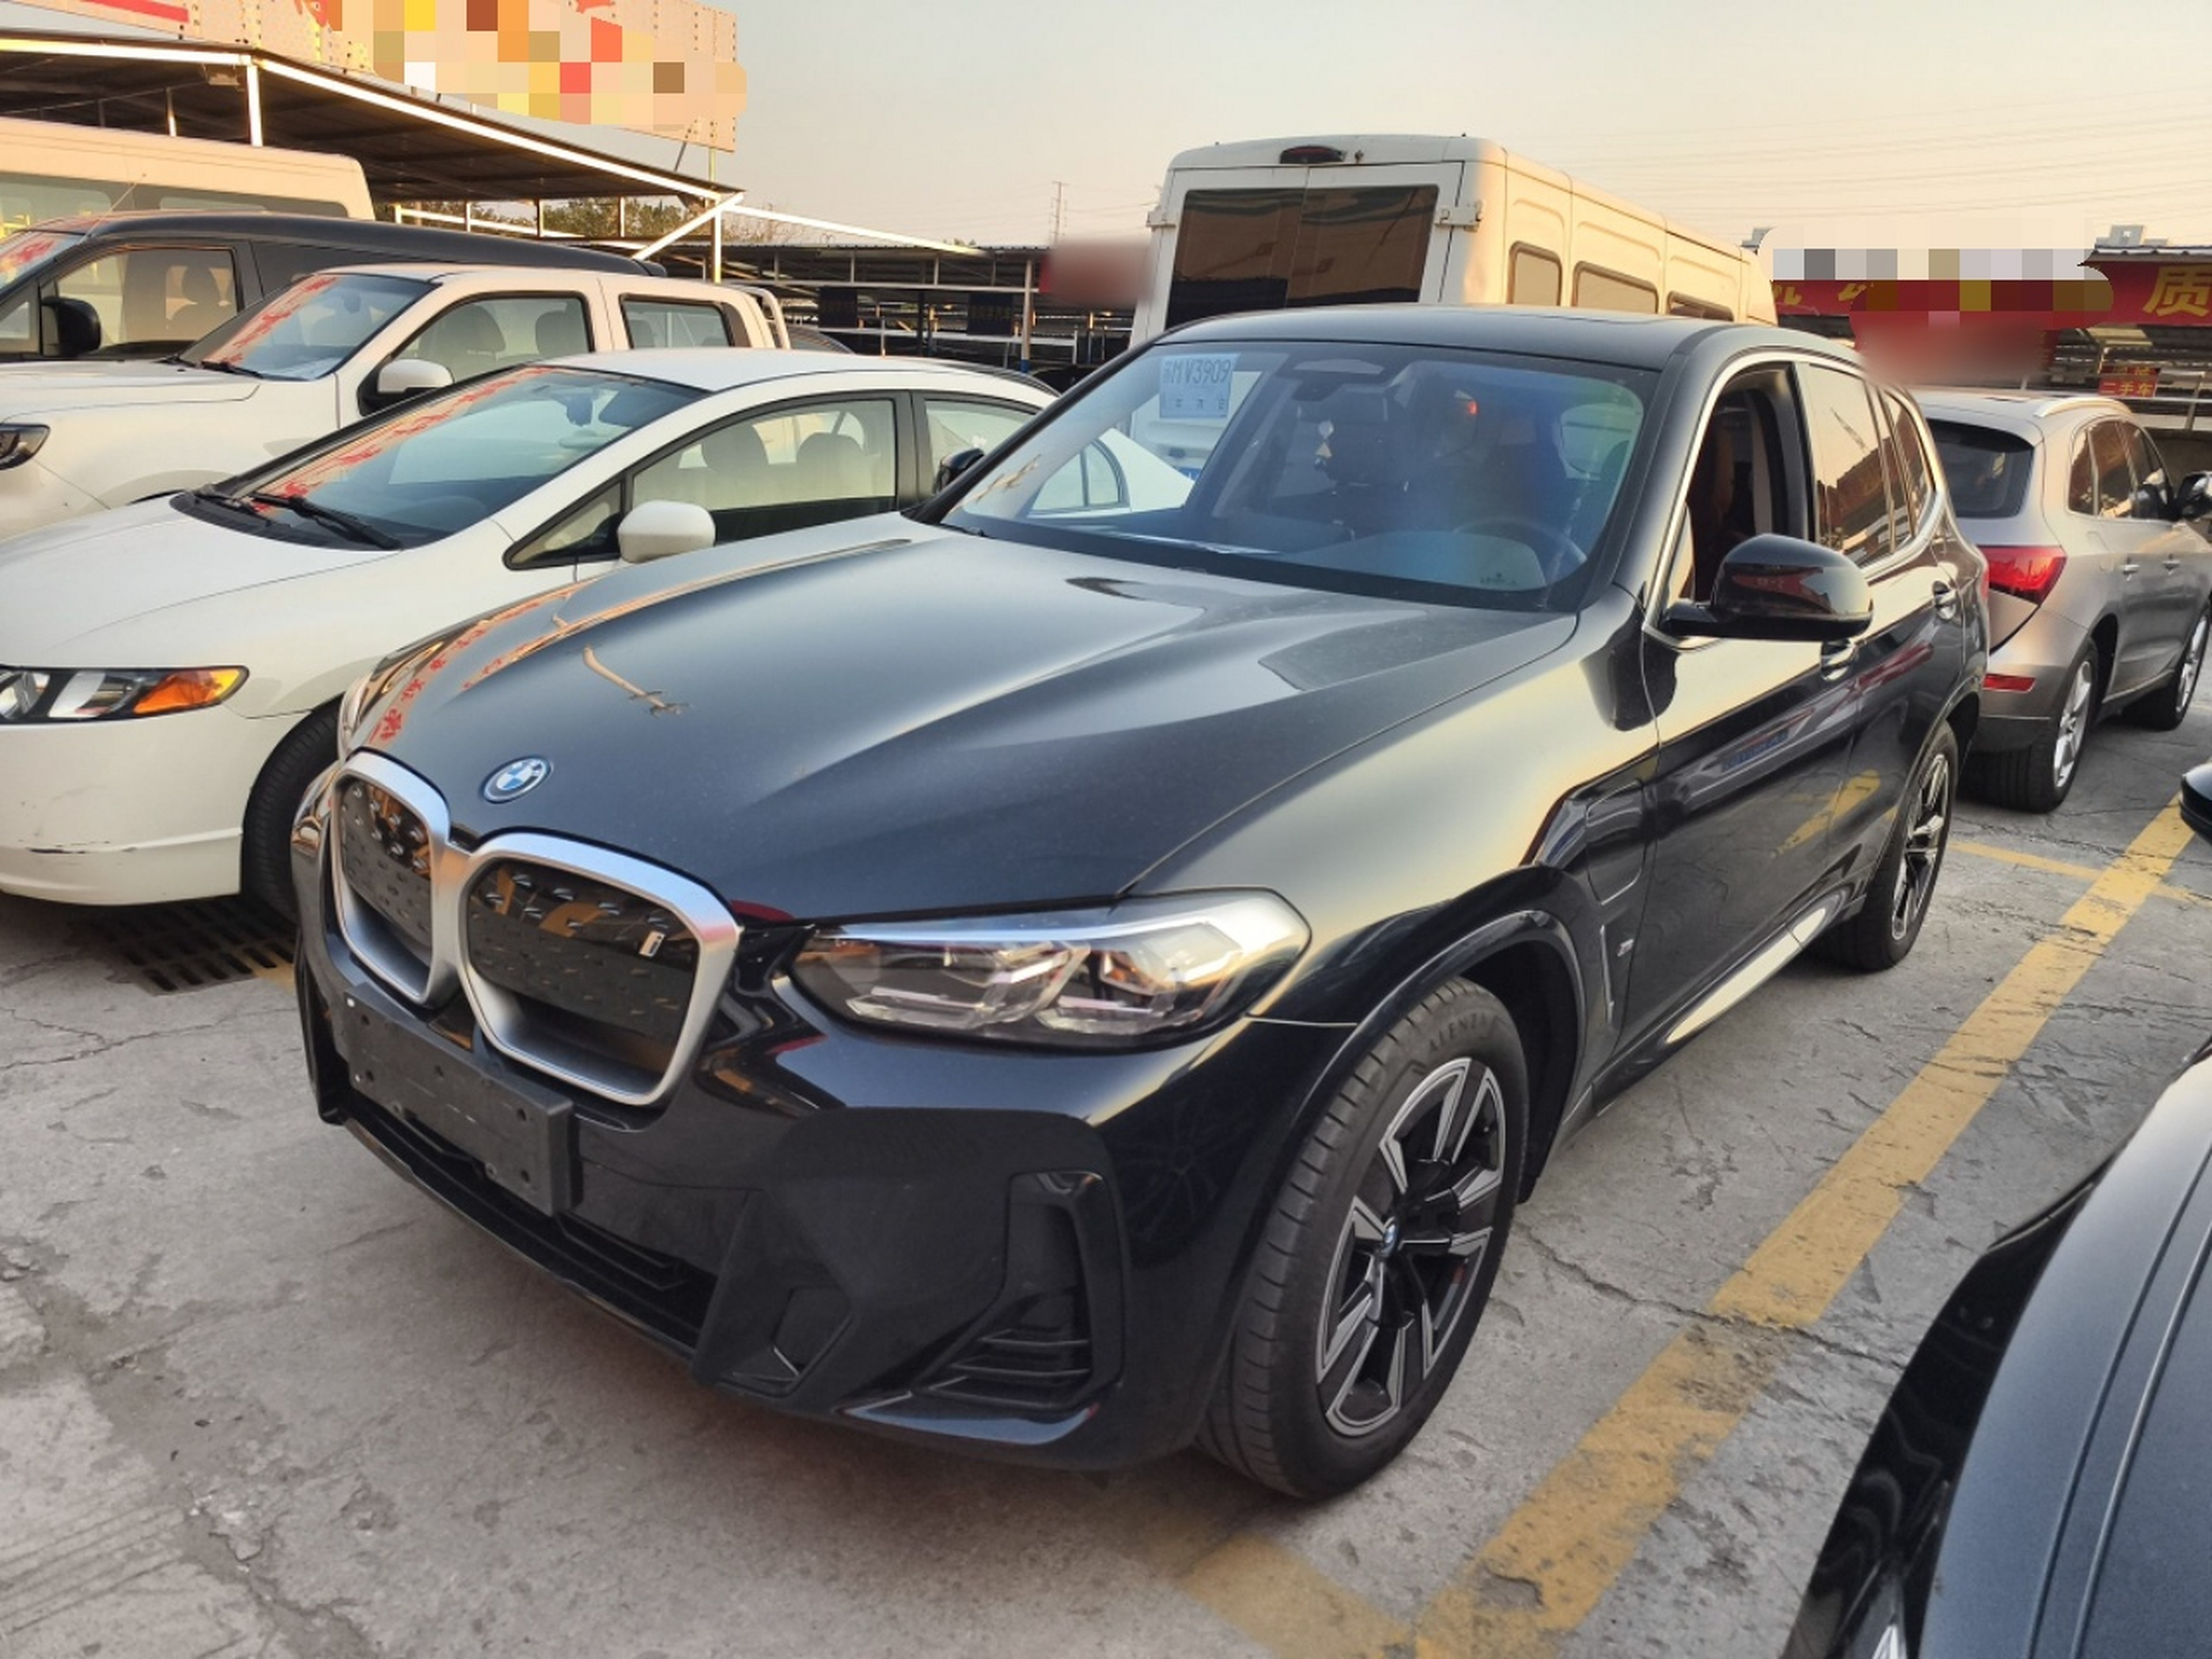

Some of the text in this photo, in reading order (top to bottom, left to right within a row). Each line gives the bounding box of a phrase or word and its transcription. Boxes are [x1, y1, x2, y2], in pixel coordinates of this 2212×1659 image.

[2142, 266, 2210, 317] 质
[2101, 381, 2154, 397] 二手车
